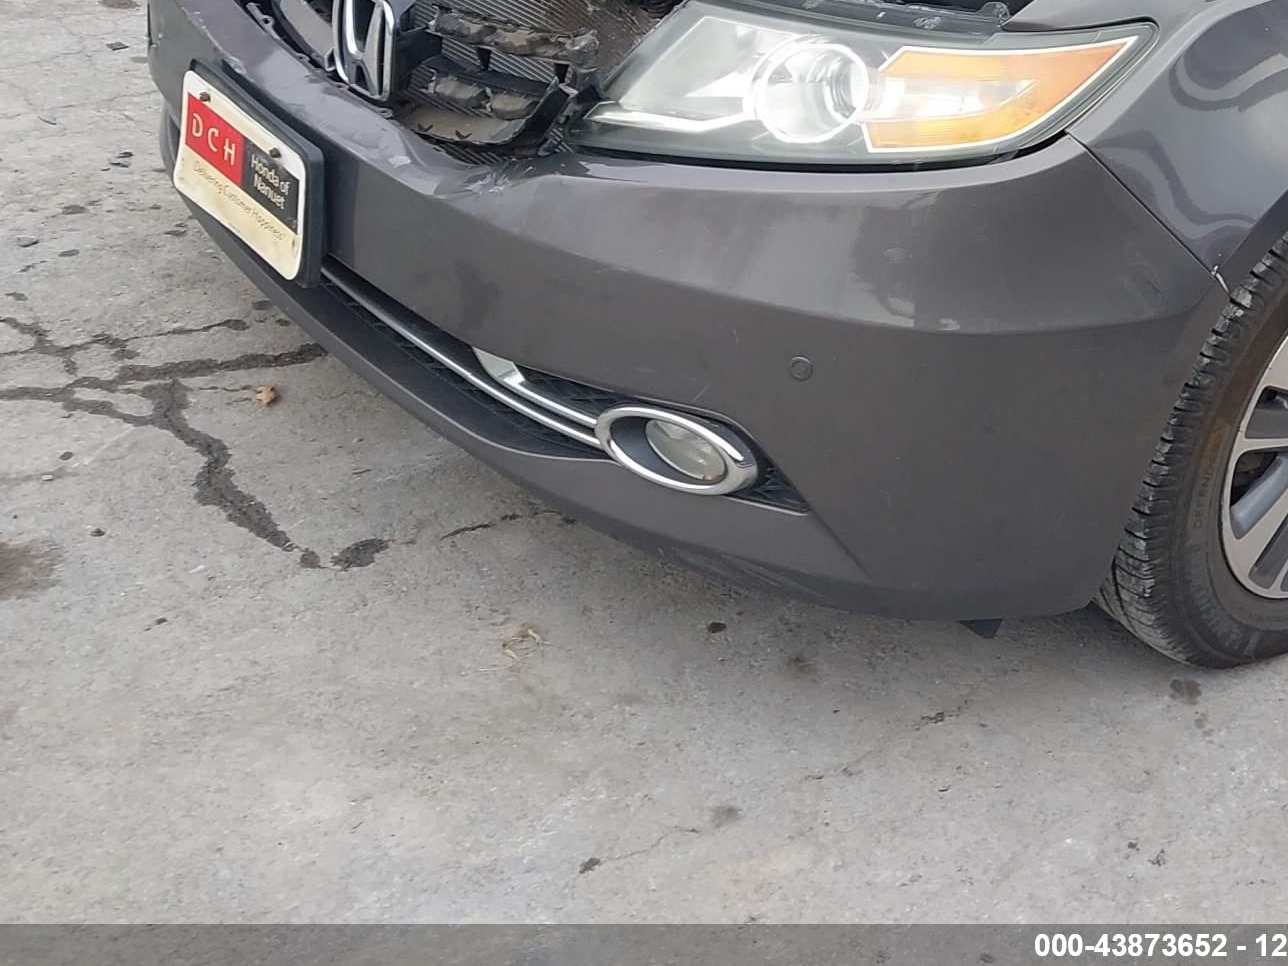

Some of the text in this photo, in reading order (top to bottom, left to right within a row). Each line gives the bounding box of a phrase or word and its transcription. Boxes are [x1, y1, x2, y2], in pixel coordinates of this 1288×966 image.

[250, 153, 291, 196] Honda of
[253, 173, 285, 210] Nanuet
